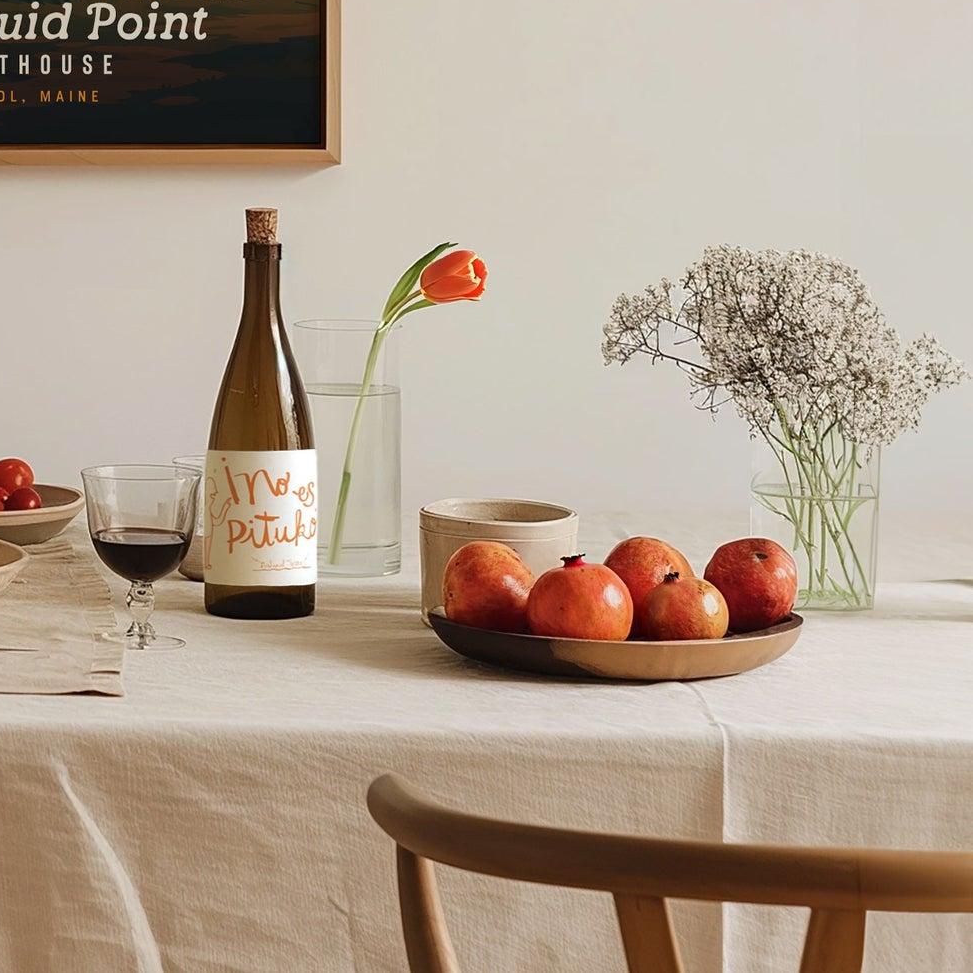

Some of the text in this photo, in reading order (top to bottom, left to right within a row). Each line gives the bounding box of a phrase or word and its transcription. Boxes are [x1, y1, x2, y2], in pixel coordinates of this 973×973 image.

[87, 1, 208, 40] Point
[40, 90, 100, 103] MAINE
[292, 481, 315, 507] es
